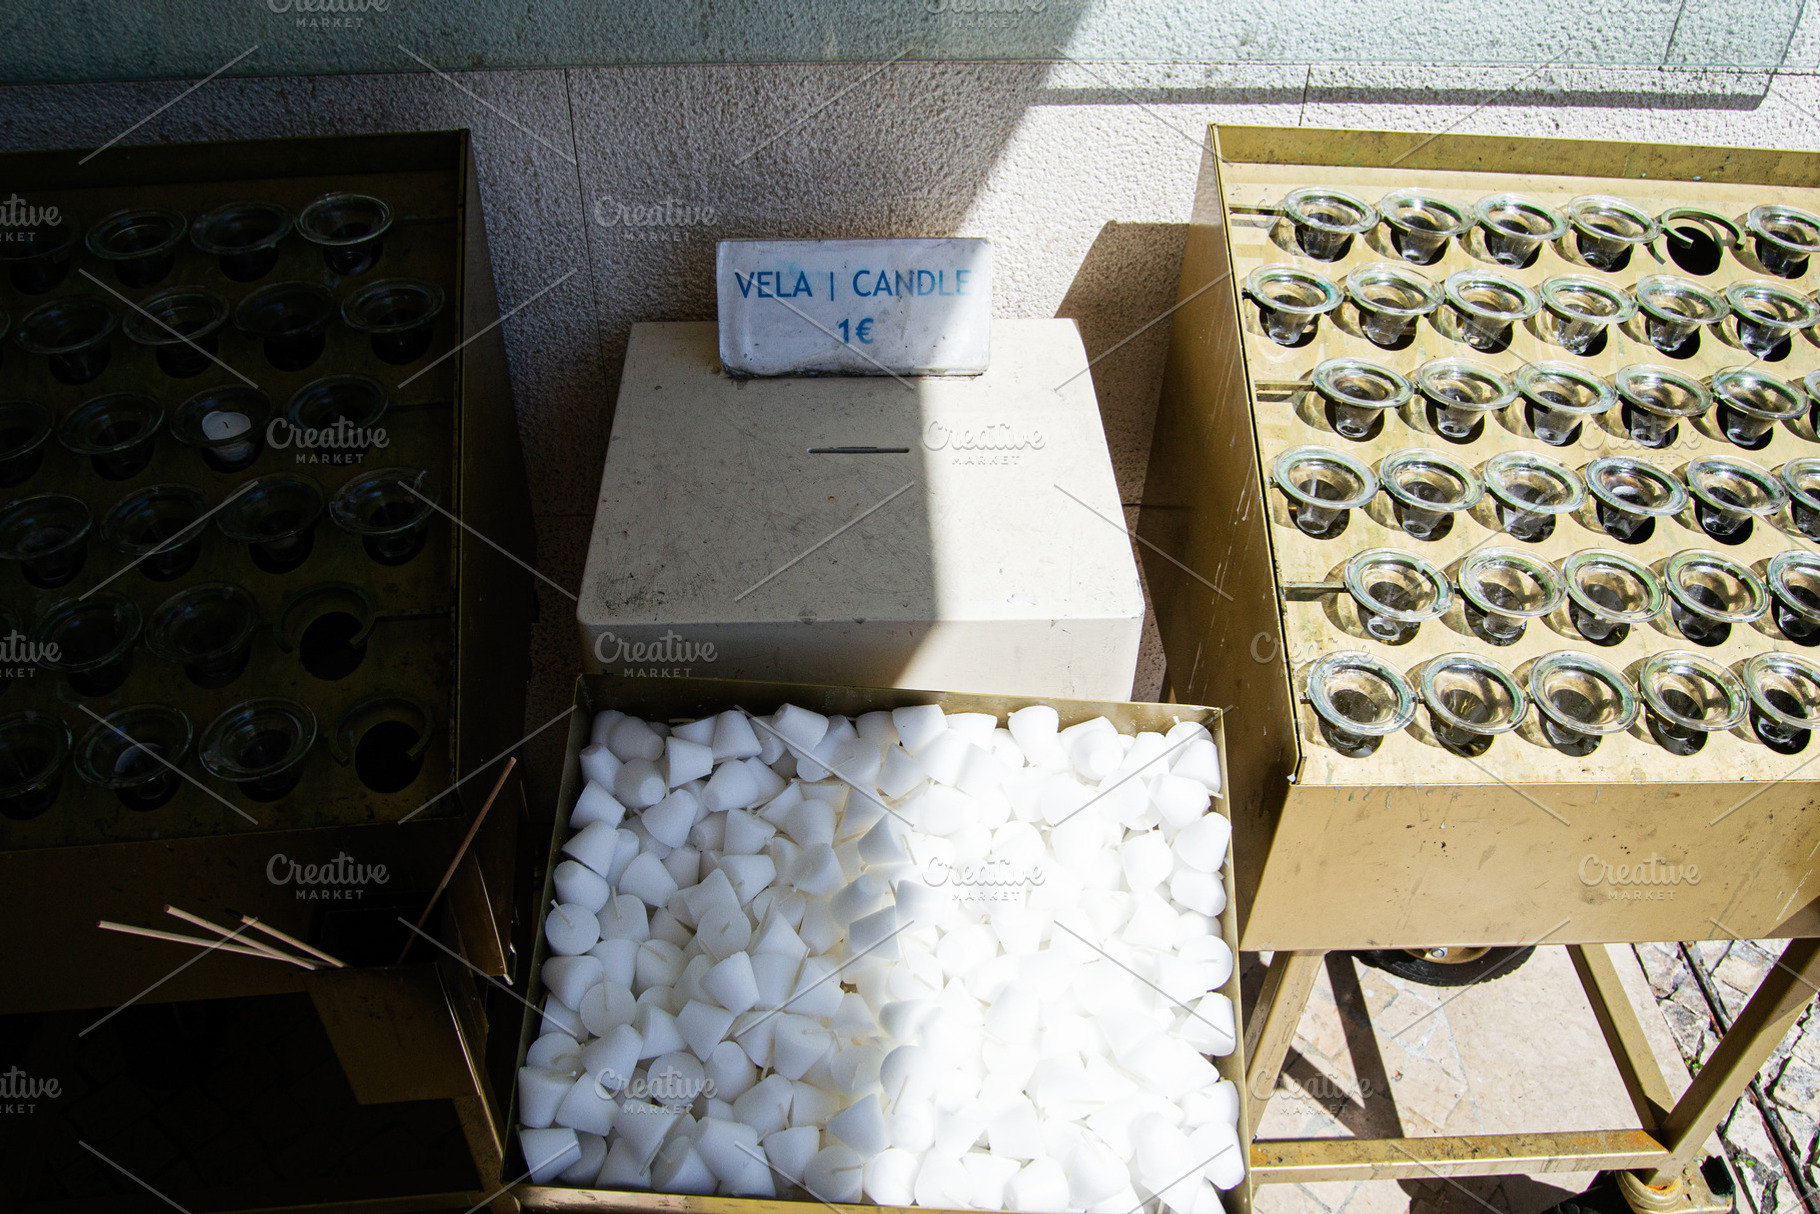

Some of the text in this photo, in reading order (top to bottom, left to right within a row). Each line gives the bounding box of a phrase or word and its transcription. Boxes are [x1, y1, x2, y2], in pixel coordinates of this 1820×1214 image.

[734, 270, 813, 299] VELA
[852, 269, 973, 297] CANDLE
[838, 317, 875, 344] 1€
